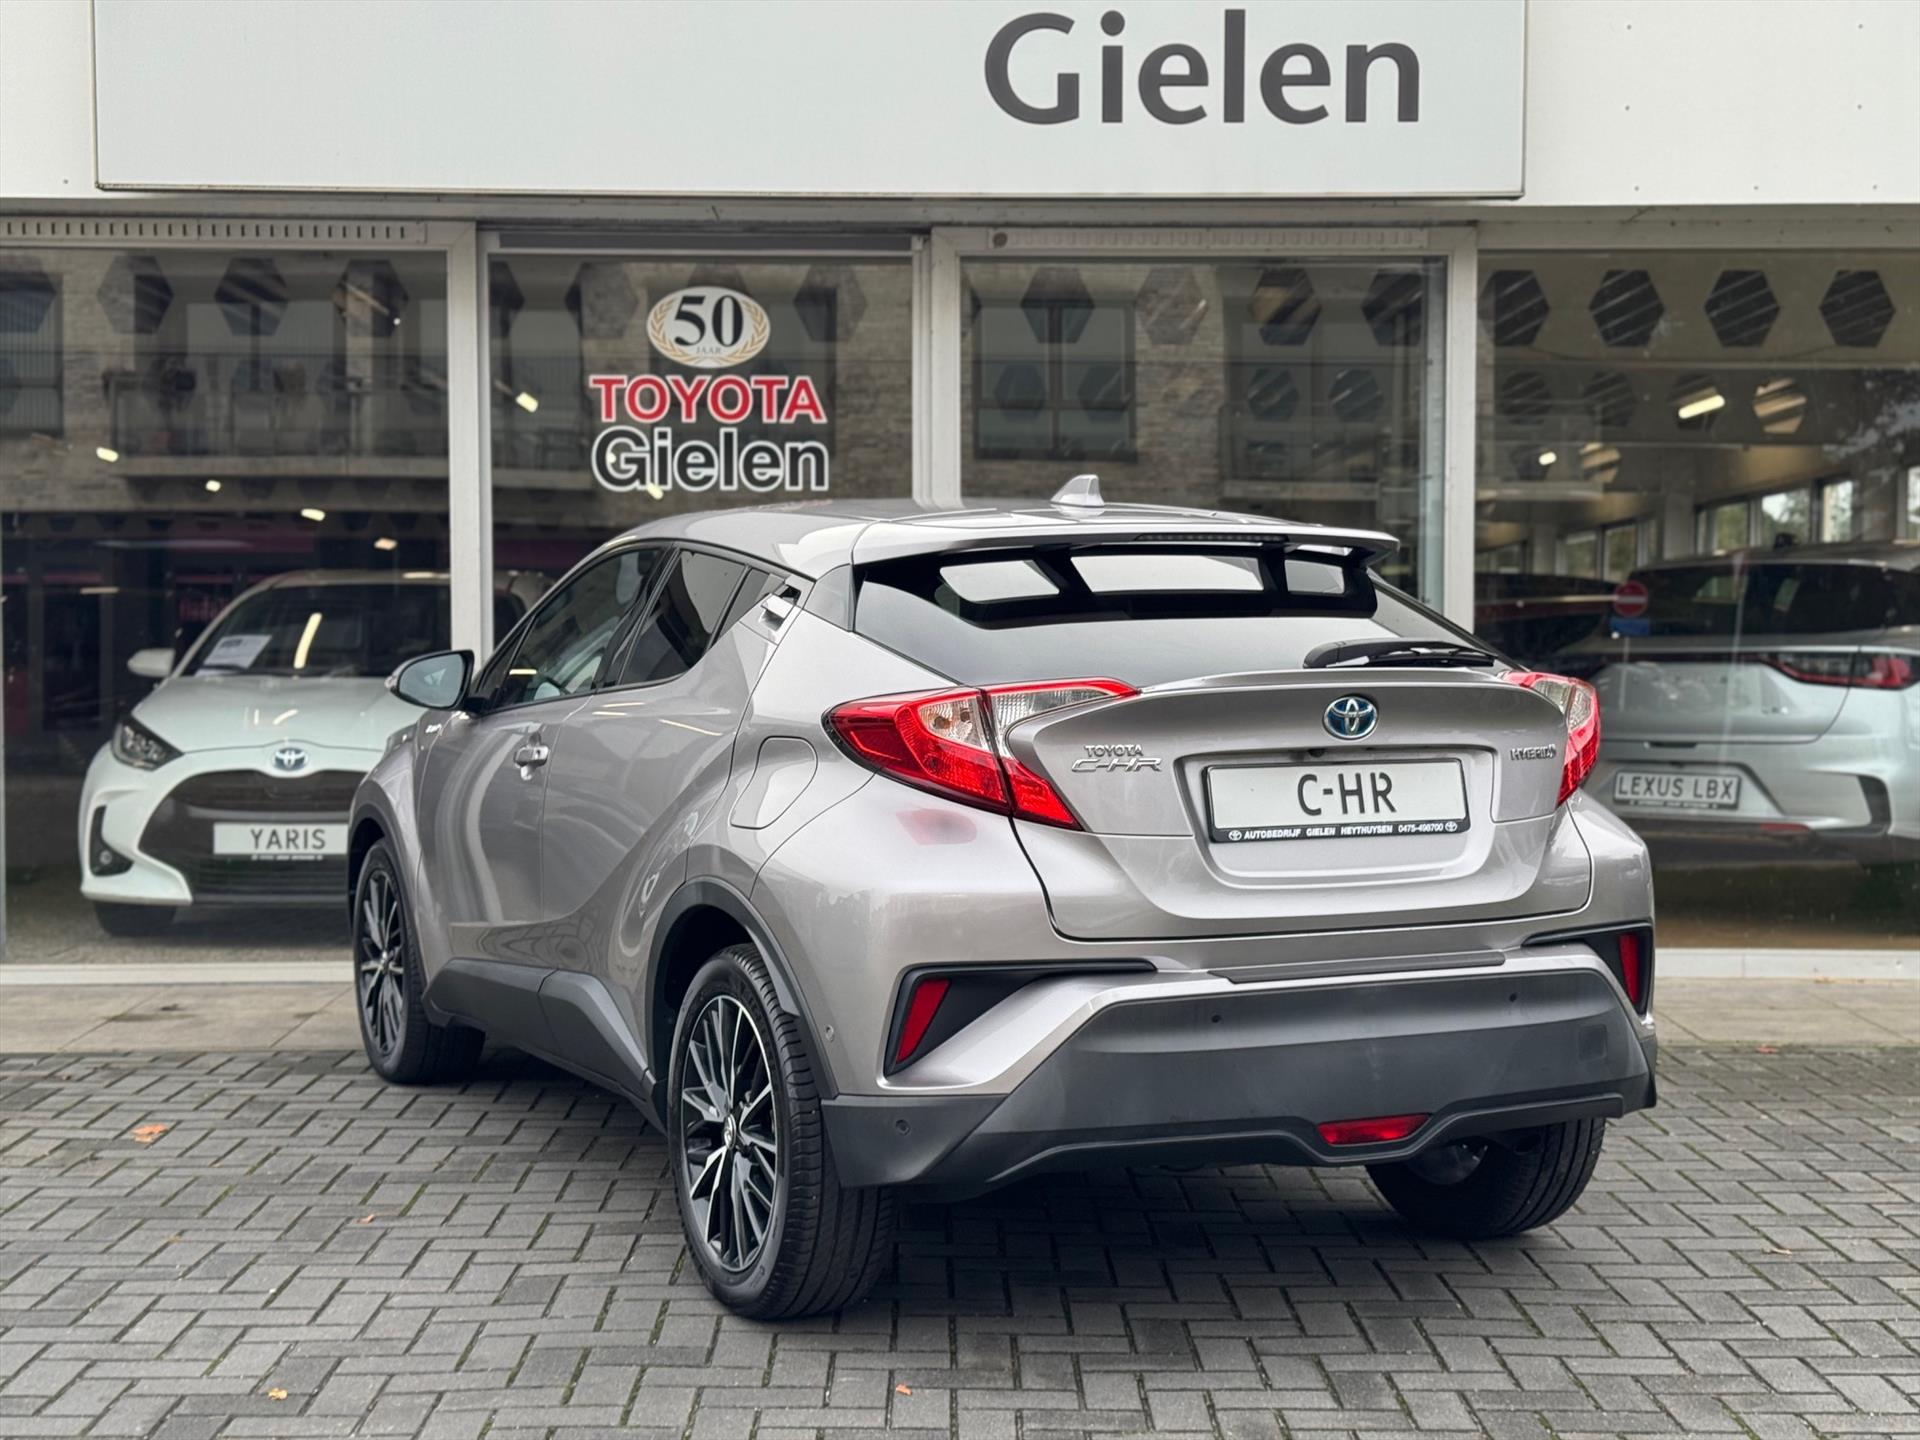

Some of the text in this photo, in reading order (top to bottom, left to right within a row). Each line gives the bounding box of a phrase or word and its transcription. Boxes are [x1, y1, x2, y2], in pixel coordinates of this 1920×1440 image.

[984, 9, 1420, 125] Gielen
[674, 294, 744, 347] 50
[589, 374, 828, 424] TOYOTA
[591, 425, 830, 492] Gielen
[1071, 757, 1162, 773] C-HR
[1084, 744, 1143, 757] TOYOTA
[1297, 771, 1397, 816] C-HR
[1618, 775, 1733, 799] LEXUS LBX
[250, 828, 326, 850] YARIS
[1244, 828, 1301, 840] AUTOBEDRIJF
[1306, 827, 1336, 836] GIELEN
[1340, 824, 1393, 835] HEYTHUYSEN
